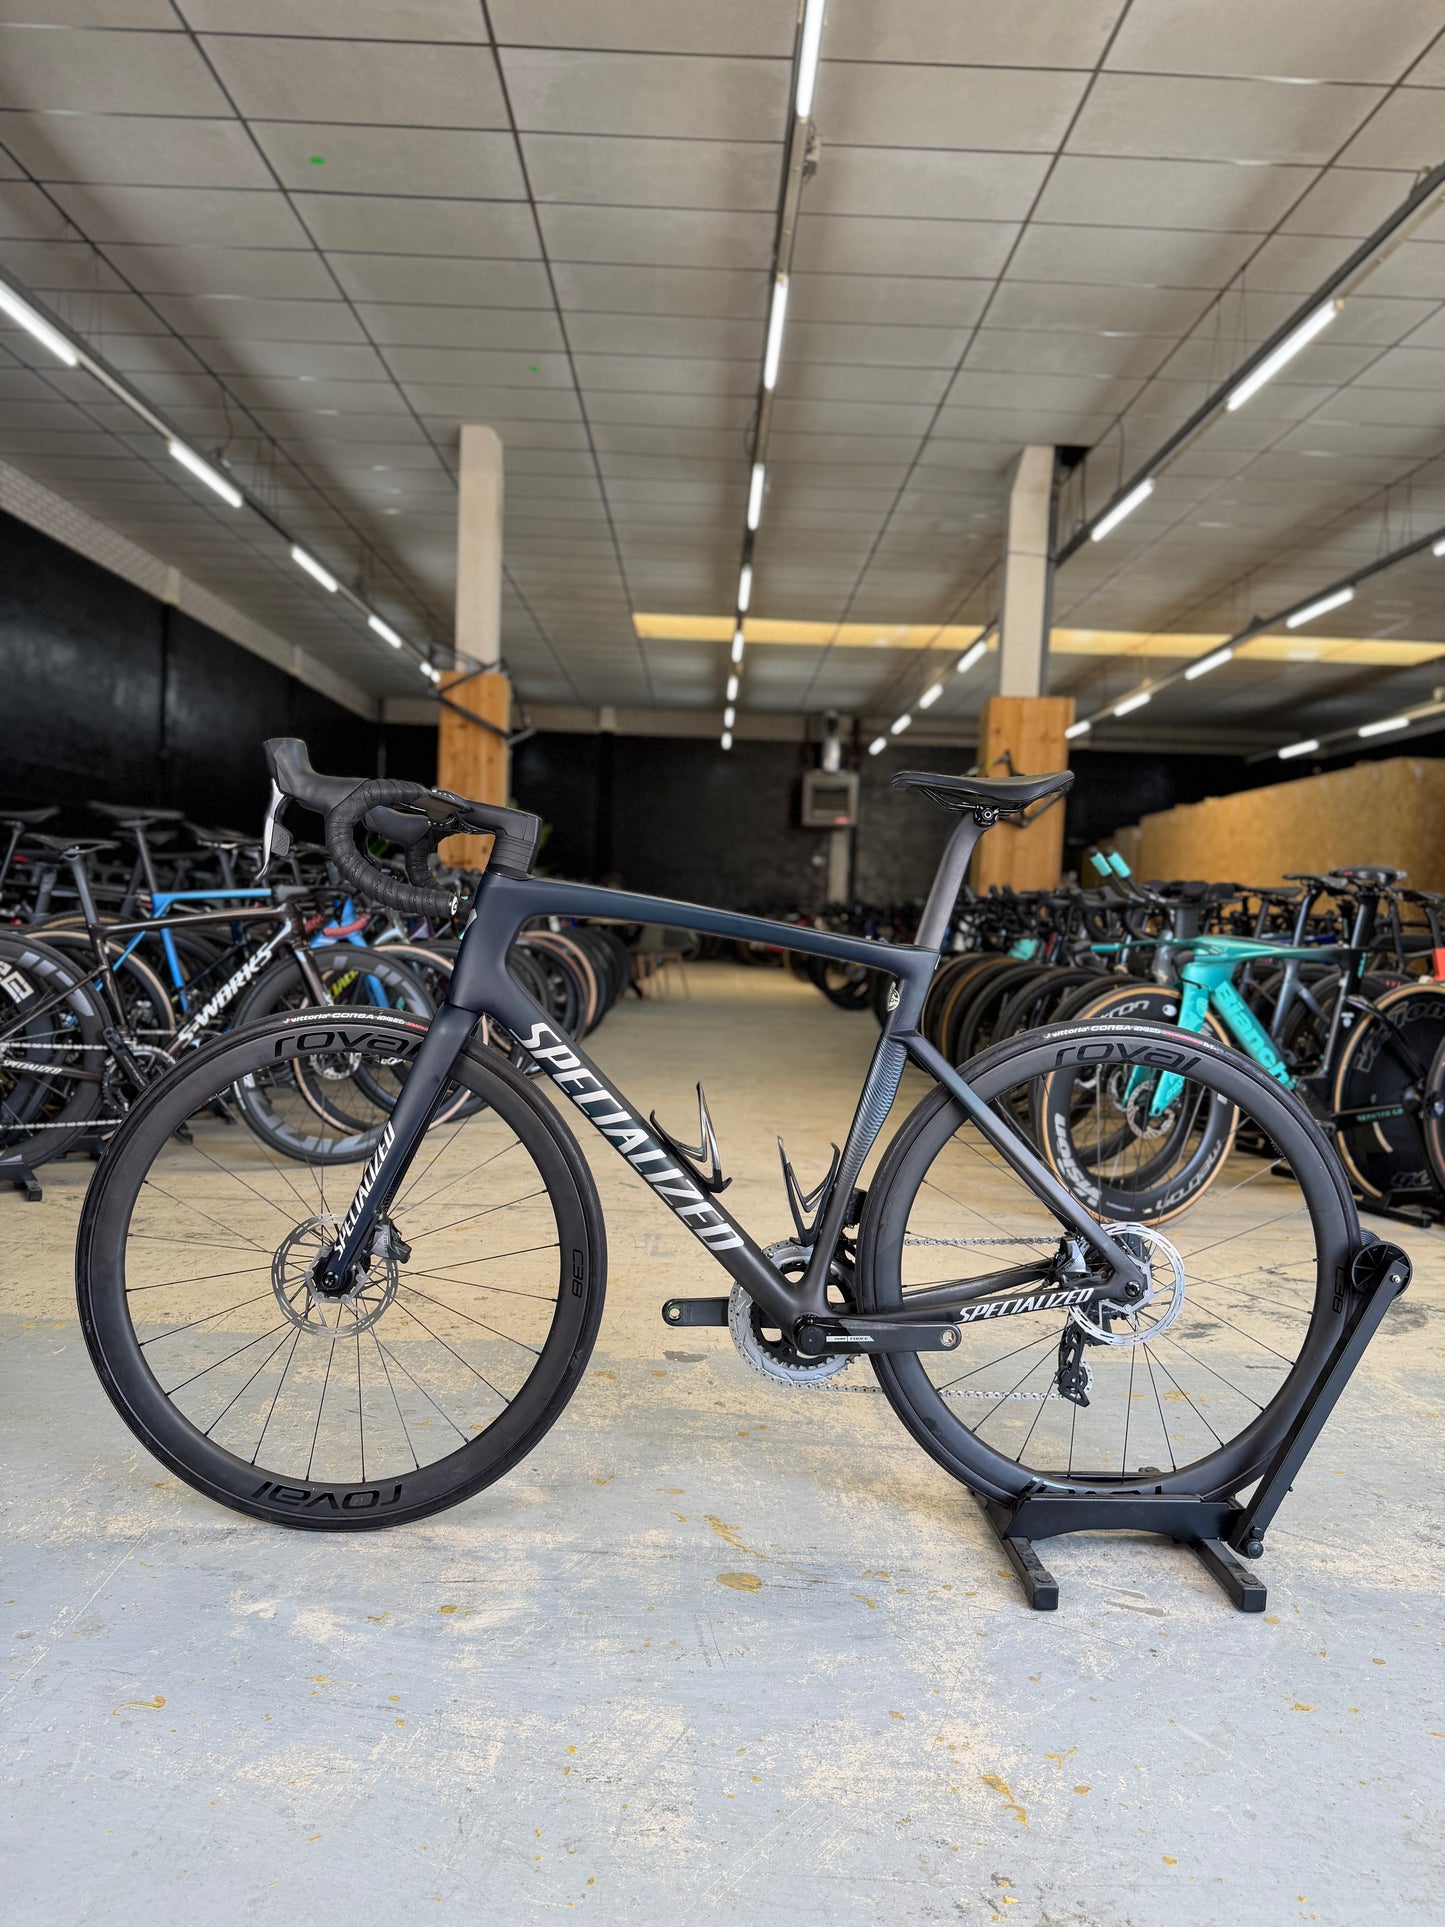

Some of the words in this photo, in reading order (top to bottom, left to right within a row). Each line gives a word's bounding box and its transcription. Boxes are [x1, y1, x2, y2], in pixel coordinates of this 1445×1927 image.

[177, 942, 272, 1042] S-WORKS
[290, 1013, 328, 1023] vittoria
[332, 1012, 374, 1020] CORSA
[1052, 1027, 1087, 1038] vittoria
[1091, 1024, 1131, 1032] CORSA
[3, 1059, 63, 1076] SPECIALIZED
[1055, 1043, 1202, 1072] roval
[509, 1022, 745, 1251] SPECIALIZED
[333, 1120, 396, 1261] SPECIALIZED
[571, 1248, 585, 1299] C38
[957, 1287, 1095, 1325] SPECIALIZED
[252, 1481, 403, 1510] roval
